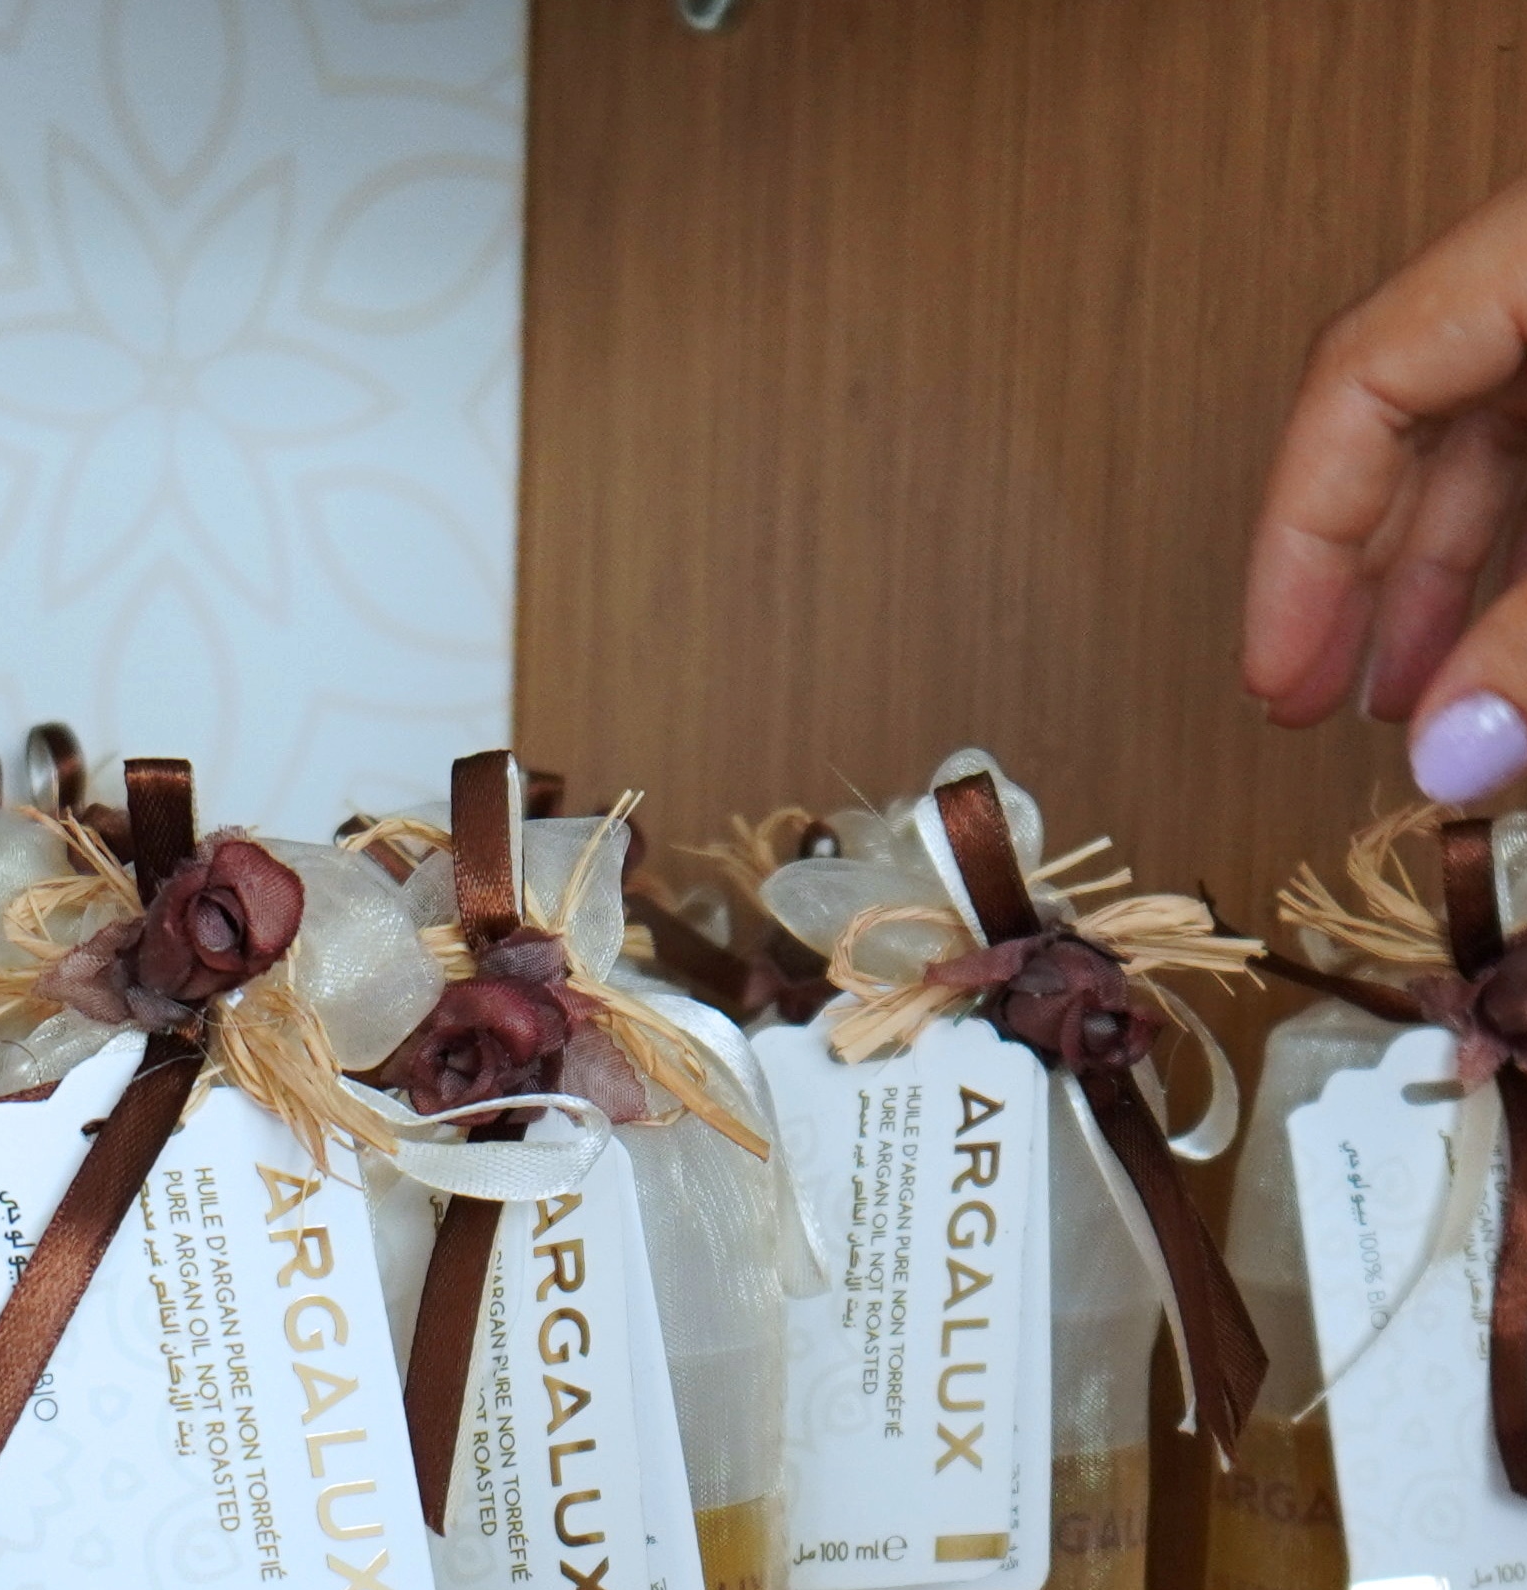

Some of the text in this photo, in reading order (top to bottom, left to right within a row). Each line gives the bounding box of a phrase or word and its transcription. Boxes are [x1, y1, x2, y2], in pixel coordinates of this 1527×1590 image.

[862, 1087, 898, 1395] PURE ARGAN OIL NOT ROASTED
[884, 1085, 921, 1438] HUILE D'ARGAN PURE NON TORRÉFIÉ
[935, 1085, 1005, 1474] ARGALUX
[1360, 1230, 1392, 1333] 100% BIO
[163, 1170, 241, 1532] PURE ARGAN OIL NOT ROASTED
[194, 1167, 287, 1582] HUILE D'ARGAN PURE NON TORRÉFIÉ
[177, 1420, 190, 1456] زيت
[473, 1431, 498, 1537] ROASTED
[496, 1416, 517, 1469] NON
[503, 1475, 533, 1583] TORRÉFIÉ
[819, 1539, 850, 1562] 100
[854, 1538, 880, 1562] ml
[1495, 1560, 1527, 1584] 100
